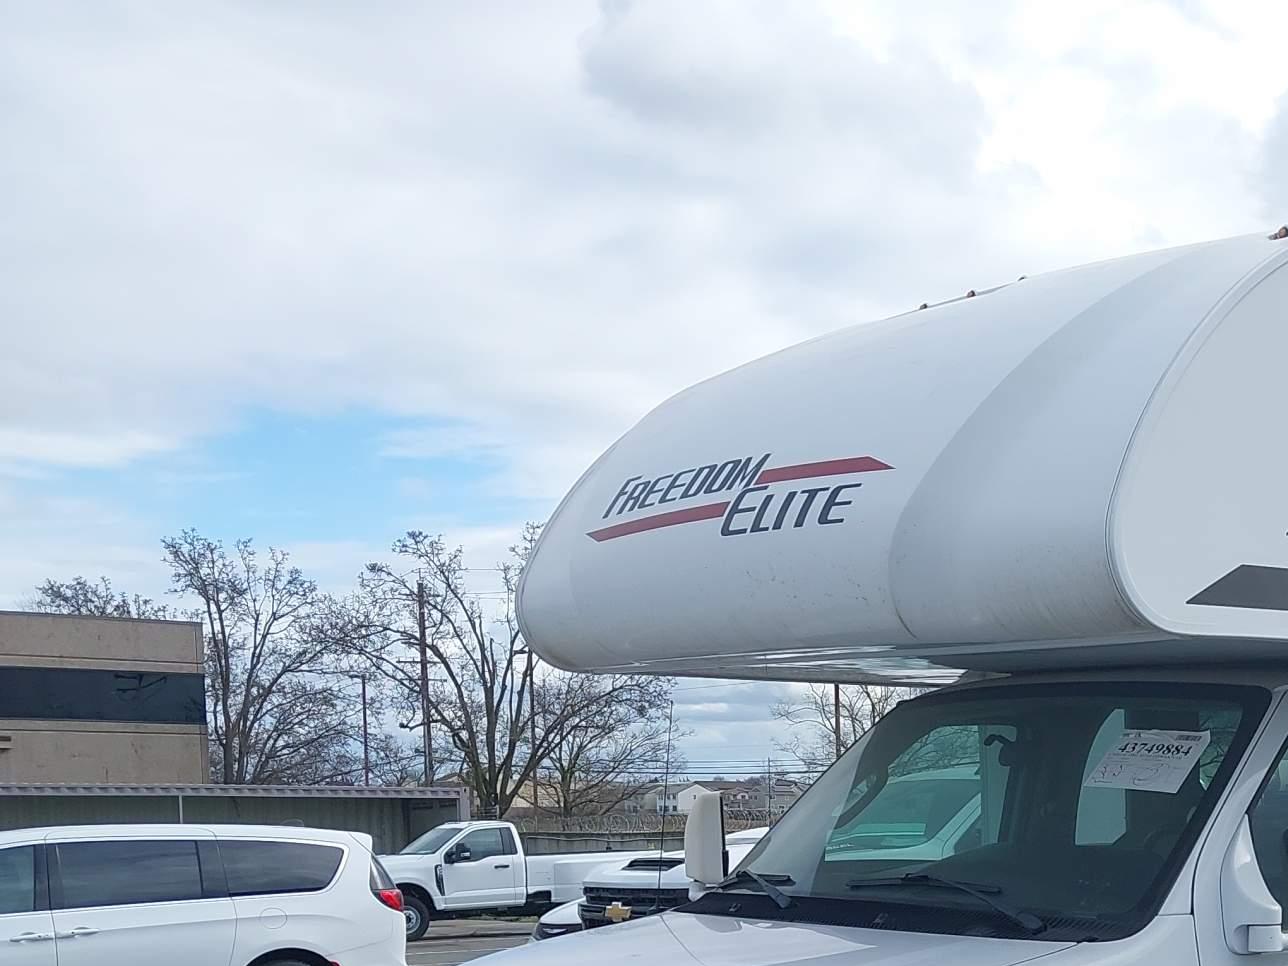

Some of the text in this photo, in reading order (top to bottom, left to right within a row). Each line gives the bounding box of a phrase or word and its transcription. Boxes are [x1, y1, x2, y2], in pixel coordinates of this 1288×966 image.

[602, 453, 771, 519] FREEDOM
[719, 483, 862, 537] ELITE
[1118, 742, 1193, 757] 43749884
